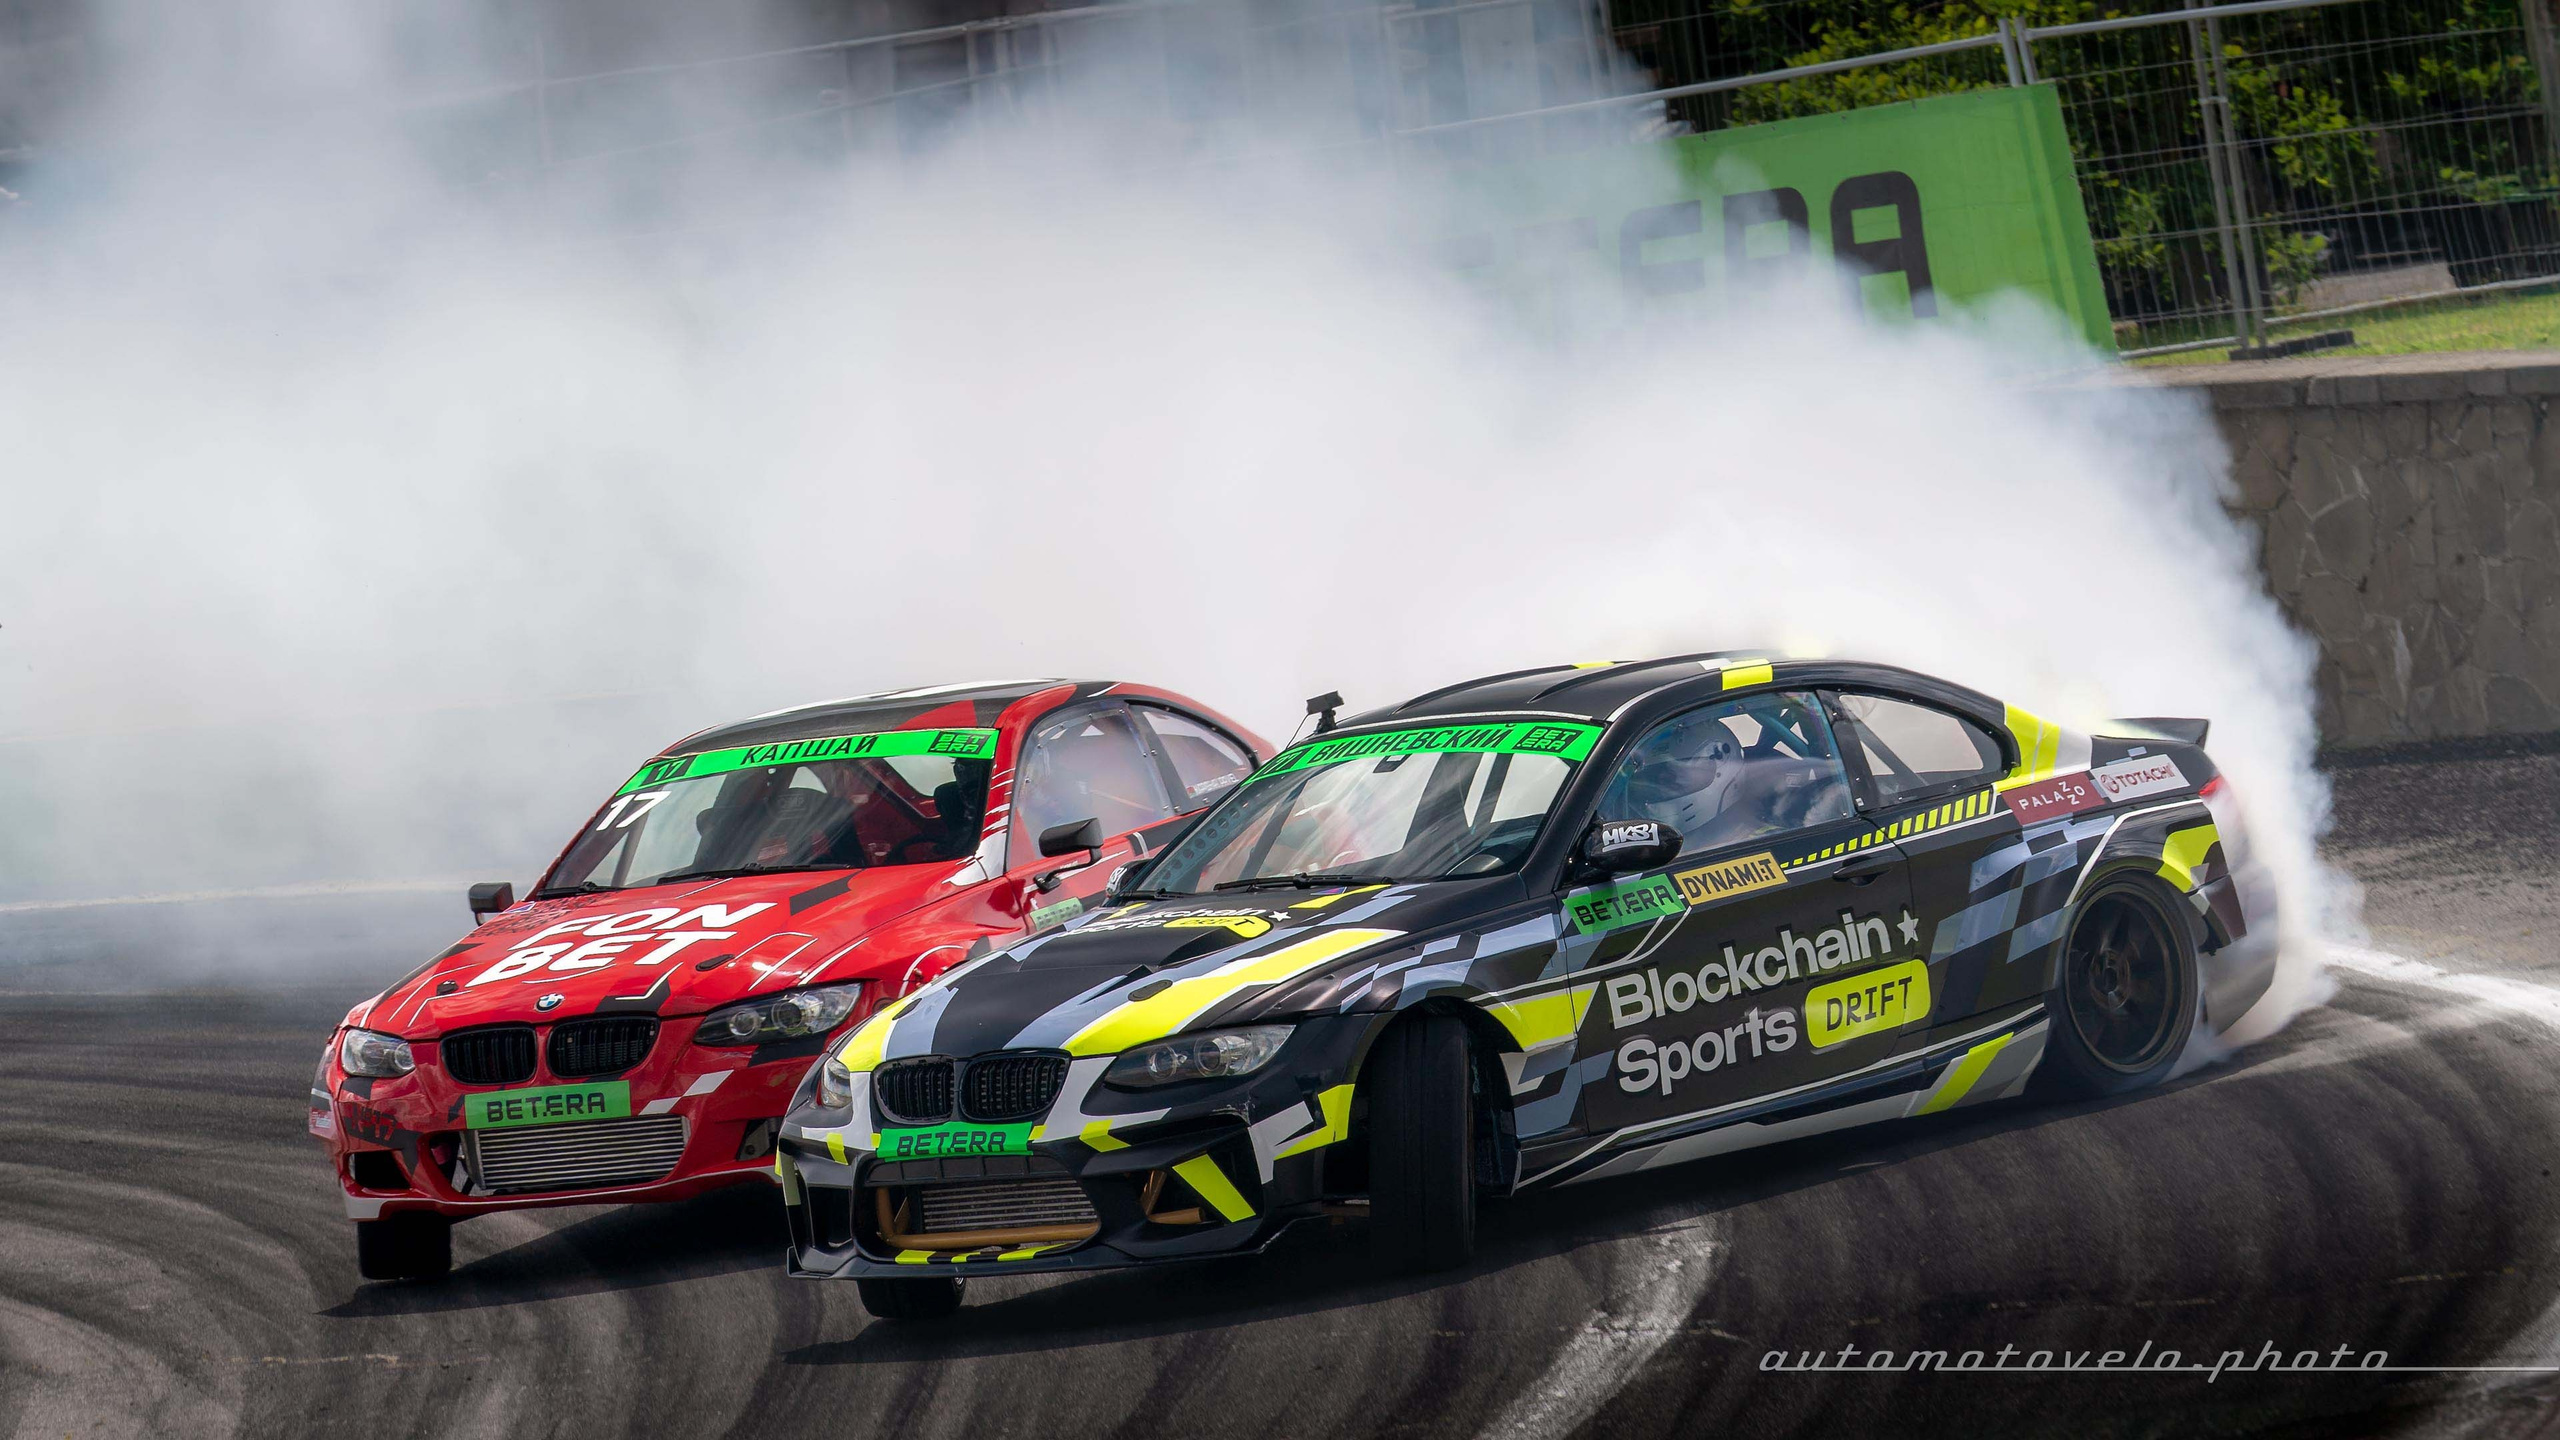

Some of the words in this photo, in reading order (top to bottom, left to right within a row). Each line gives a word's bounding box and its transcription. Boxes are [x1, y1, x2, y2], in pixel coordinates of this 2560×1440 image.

[739, 734, 879, 766] КАПШАЙ
[938, 733, 986, 744] BET
[1306, 722, 1518, 765] ВИШНЕВСКИЙ
[1529, 728, 1577, 741] BET
[654, 758, 688, 782] 17
[2115, 762, 2176, 788] TOTACHI
[595, 790, 673, 832] 17
[507, 902, 778, 951] FON
[464, 931, 738, 988] BET
[1604, 913, 1893, 1030] Blockchain
[1617, 1005, 1799, 1097] Sports
[1826, 975, 1913, 1032] DRIFT
